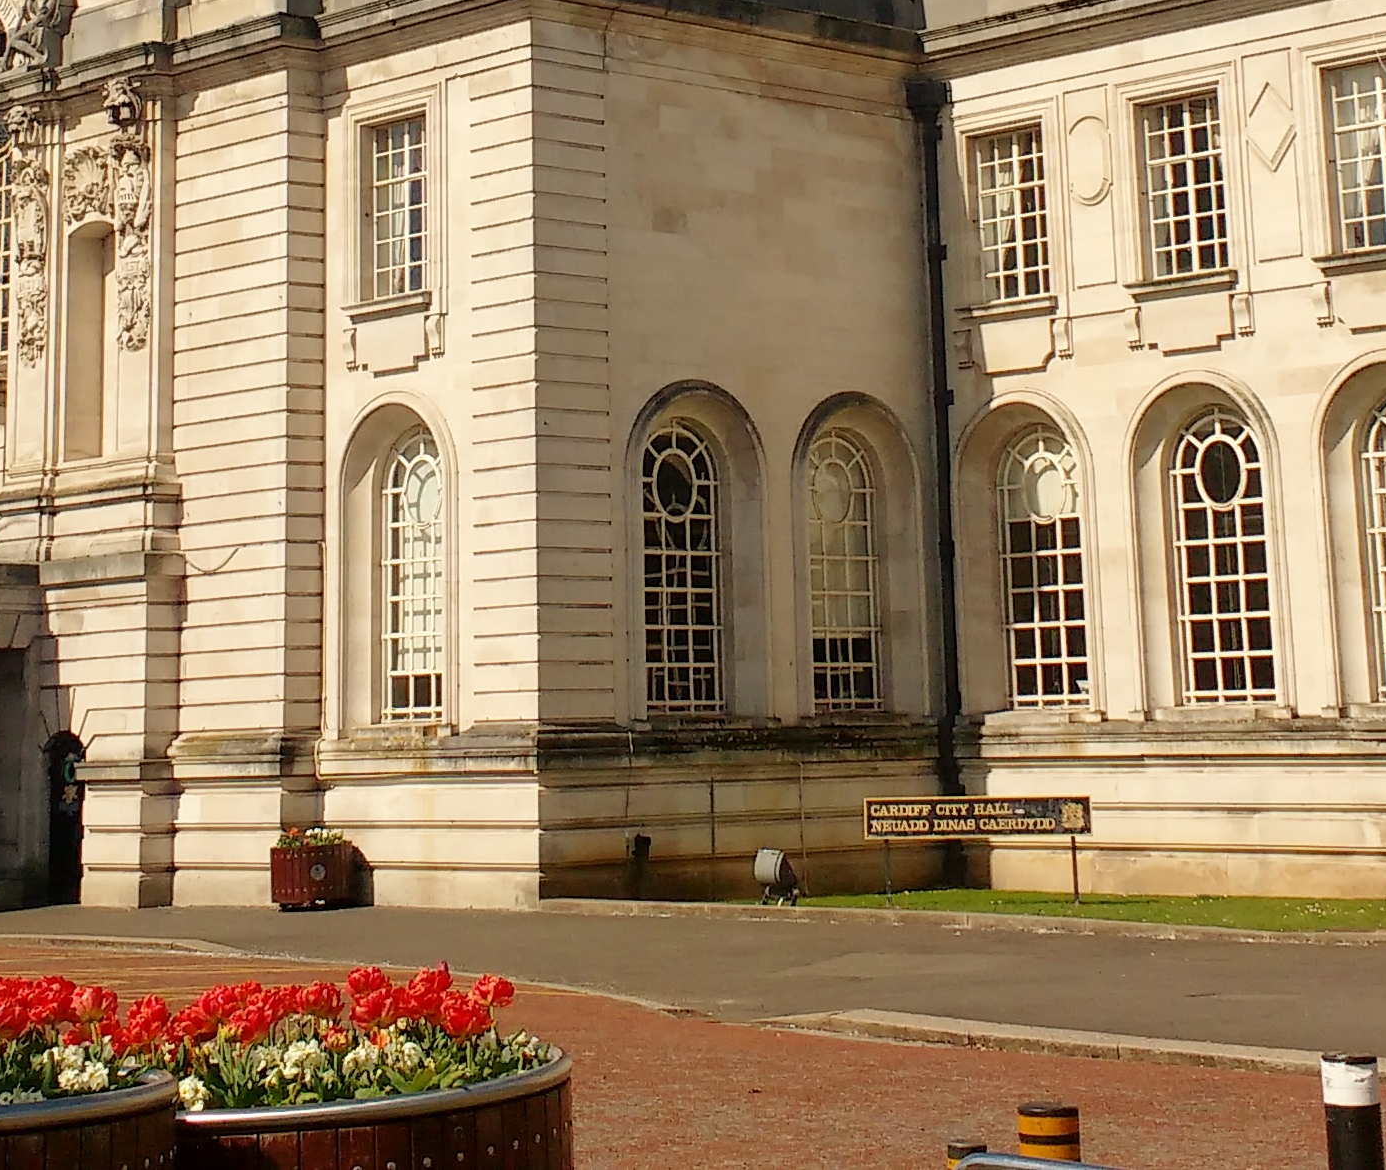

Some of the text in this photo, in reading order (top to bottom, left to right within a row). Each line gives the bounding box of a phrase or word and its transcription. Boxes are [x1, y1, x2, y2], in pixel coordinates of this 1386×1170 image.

[870, 802, 1013, 817] CARDIFF CITY HALL
[870, 817, 1056, 833] NEUADD DINAS CAERDYDD
